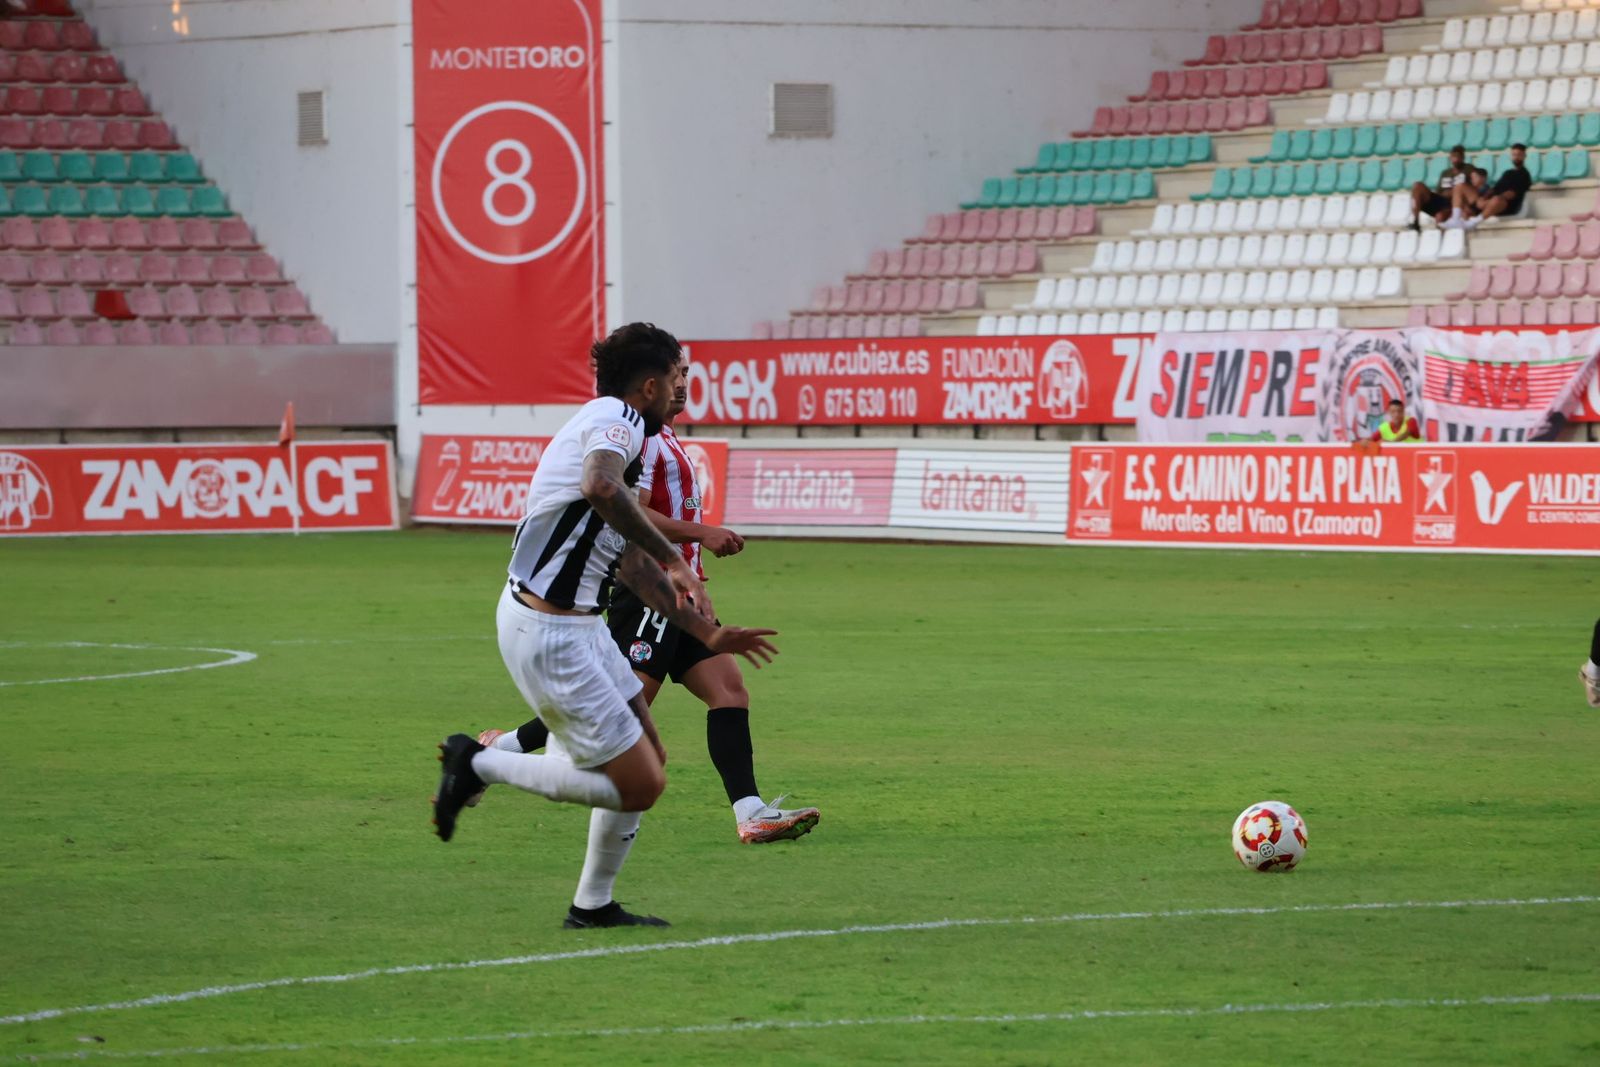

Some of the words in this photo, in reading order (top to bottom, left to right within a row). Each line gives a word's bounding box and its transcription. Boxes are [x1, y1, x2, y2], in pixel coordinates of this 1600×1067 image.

[429, 45, 585, 70] MONTETORO
[482, 139, 536, 226] 8
[781, 342, 930, 376] www.cubiex.es
[942, 340, 1035, 378] FUNDACIÓN
[685, 345, 778, 421] biex
[824, 387, 854, 417] 675
[857, 386, 885, 417] 630
[890, 386, 918, 417] 110
[1151, 348, 1320, 419] SIEMPRE
[81, 457, 303, 520] ZAMORA
[304, 456, 379, 517] CF
[456, 481, 530, 517] ZAMOR
[753, 458, 855, 511] lantana
[921, 459, 1026, 513] lantana
[1124, 454, 1162, 502] E.S.
[1167, 454, 1259, 502] CAMINO
[1264, 455, 1292, 503] DE
[1298, 456, 1327, 503] LA
[1333, 456, 1402, 504] PLATA
[1141, 505, 1211, 533] Morales
[1215, 504, 1244, 533] del
[1248, 507, 1288, 534] Vino
[1293, 507, 1382, 539] (Zamora)
[636, 606, 668, 643] 14
